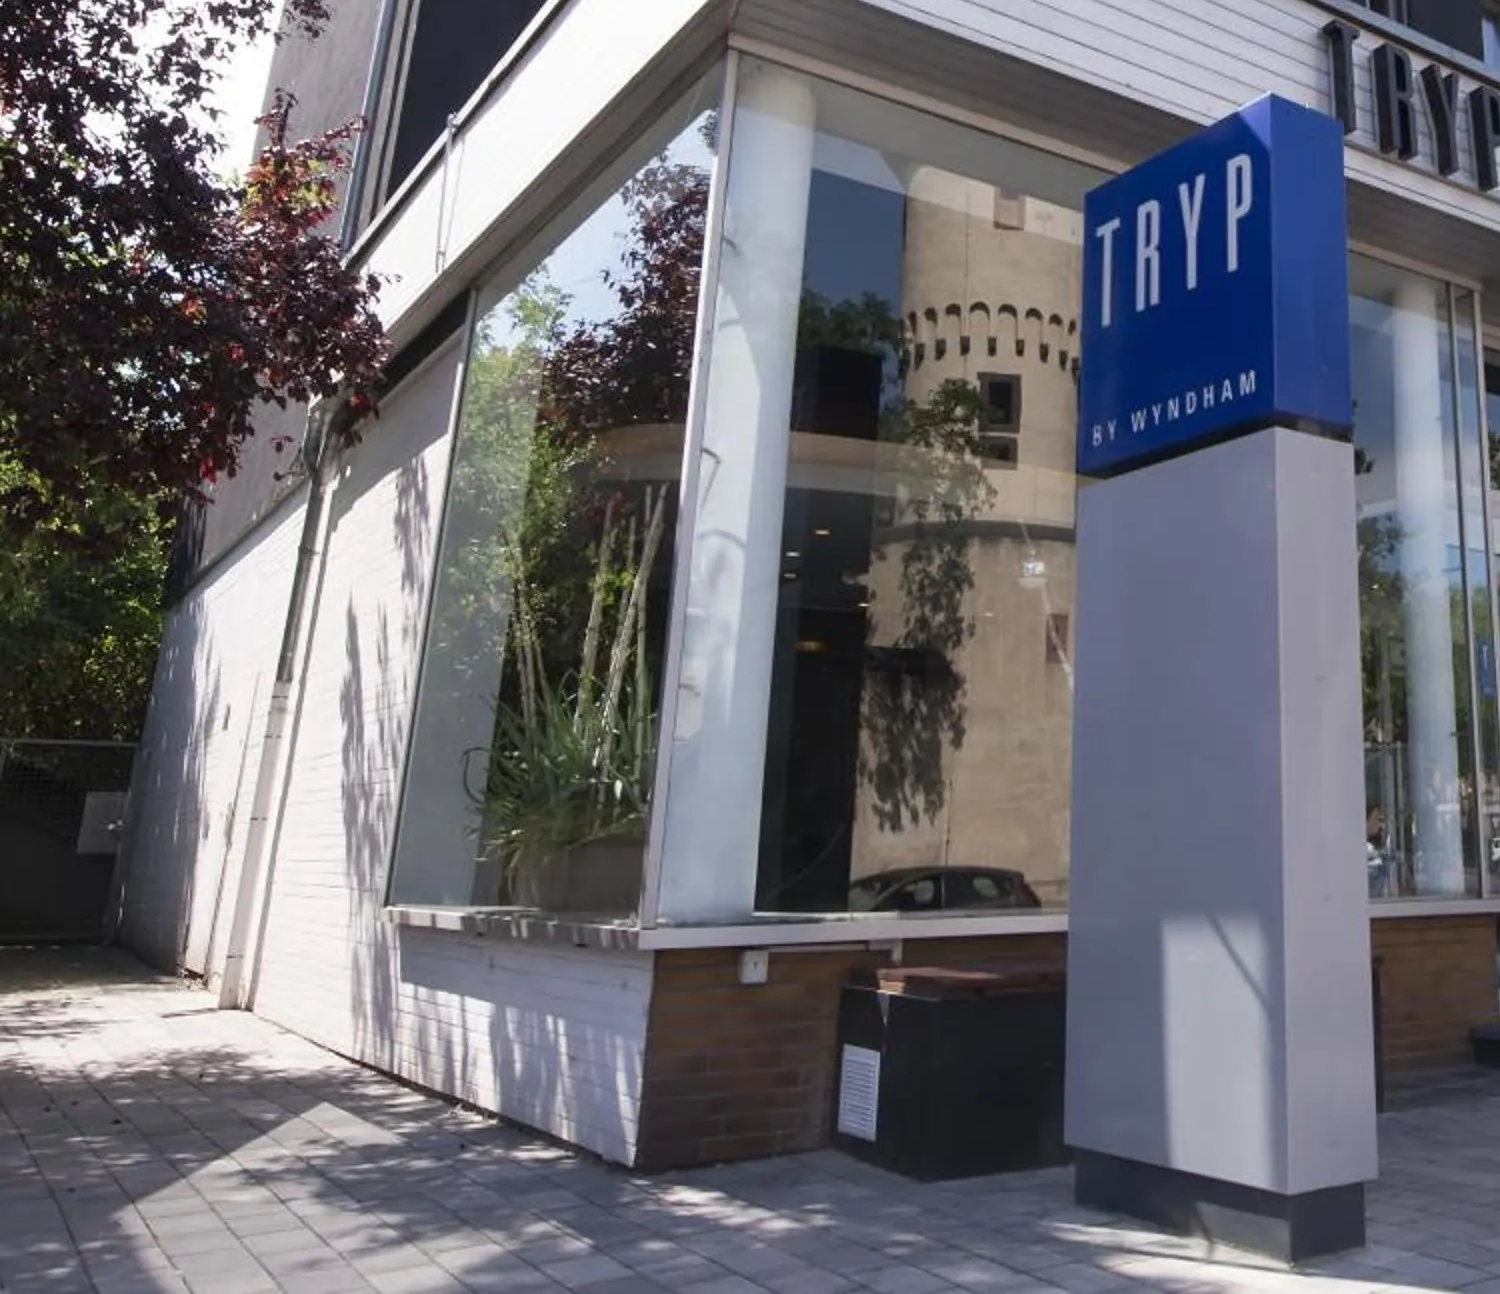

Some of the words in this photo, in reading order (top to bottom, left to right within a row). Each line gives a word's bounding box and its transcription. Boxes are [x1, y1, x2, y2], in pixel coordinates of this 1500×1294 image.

[1096, 153, 1254, 328] TRYP
[1093, 417, 1117, 447] BY
[1131, 370, 1256, 433] WYNDHAM
